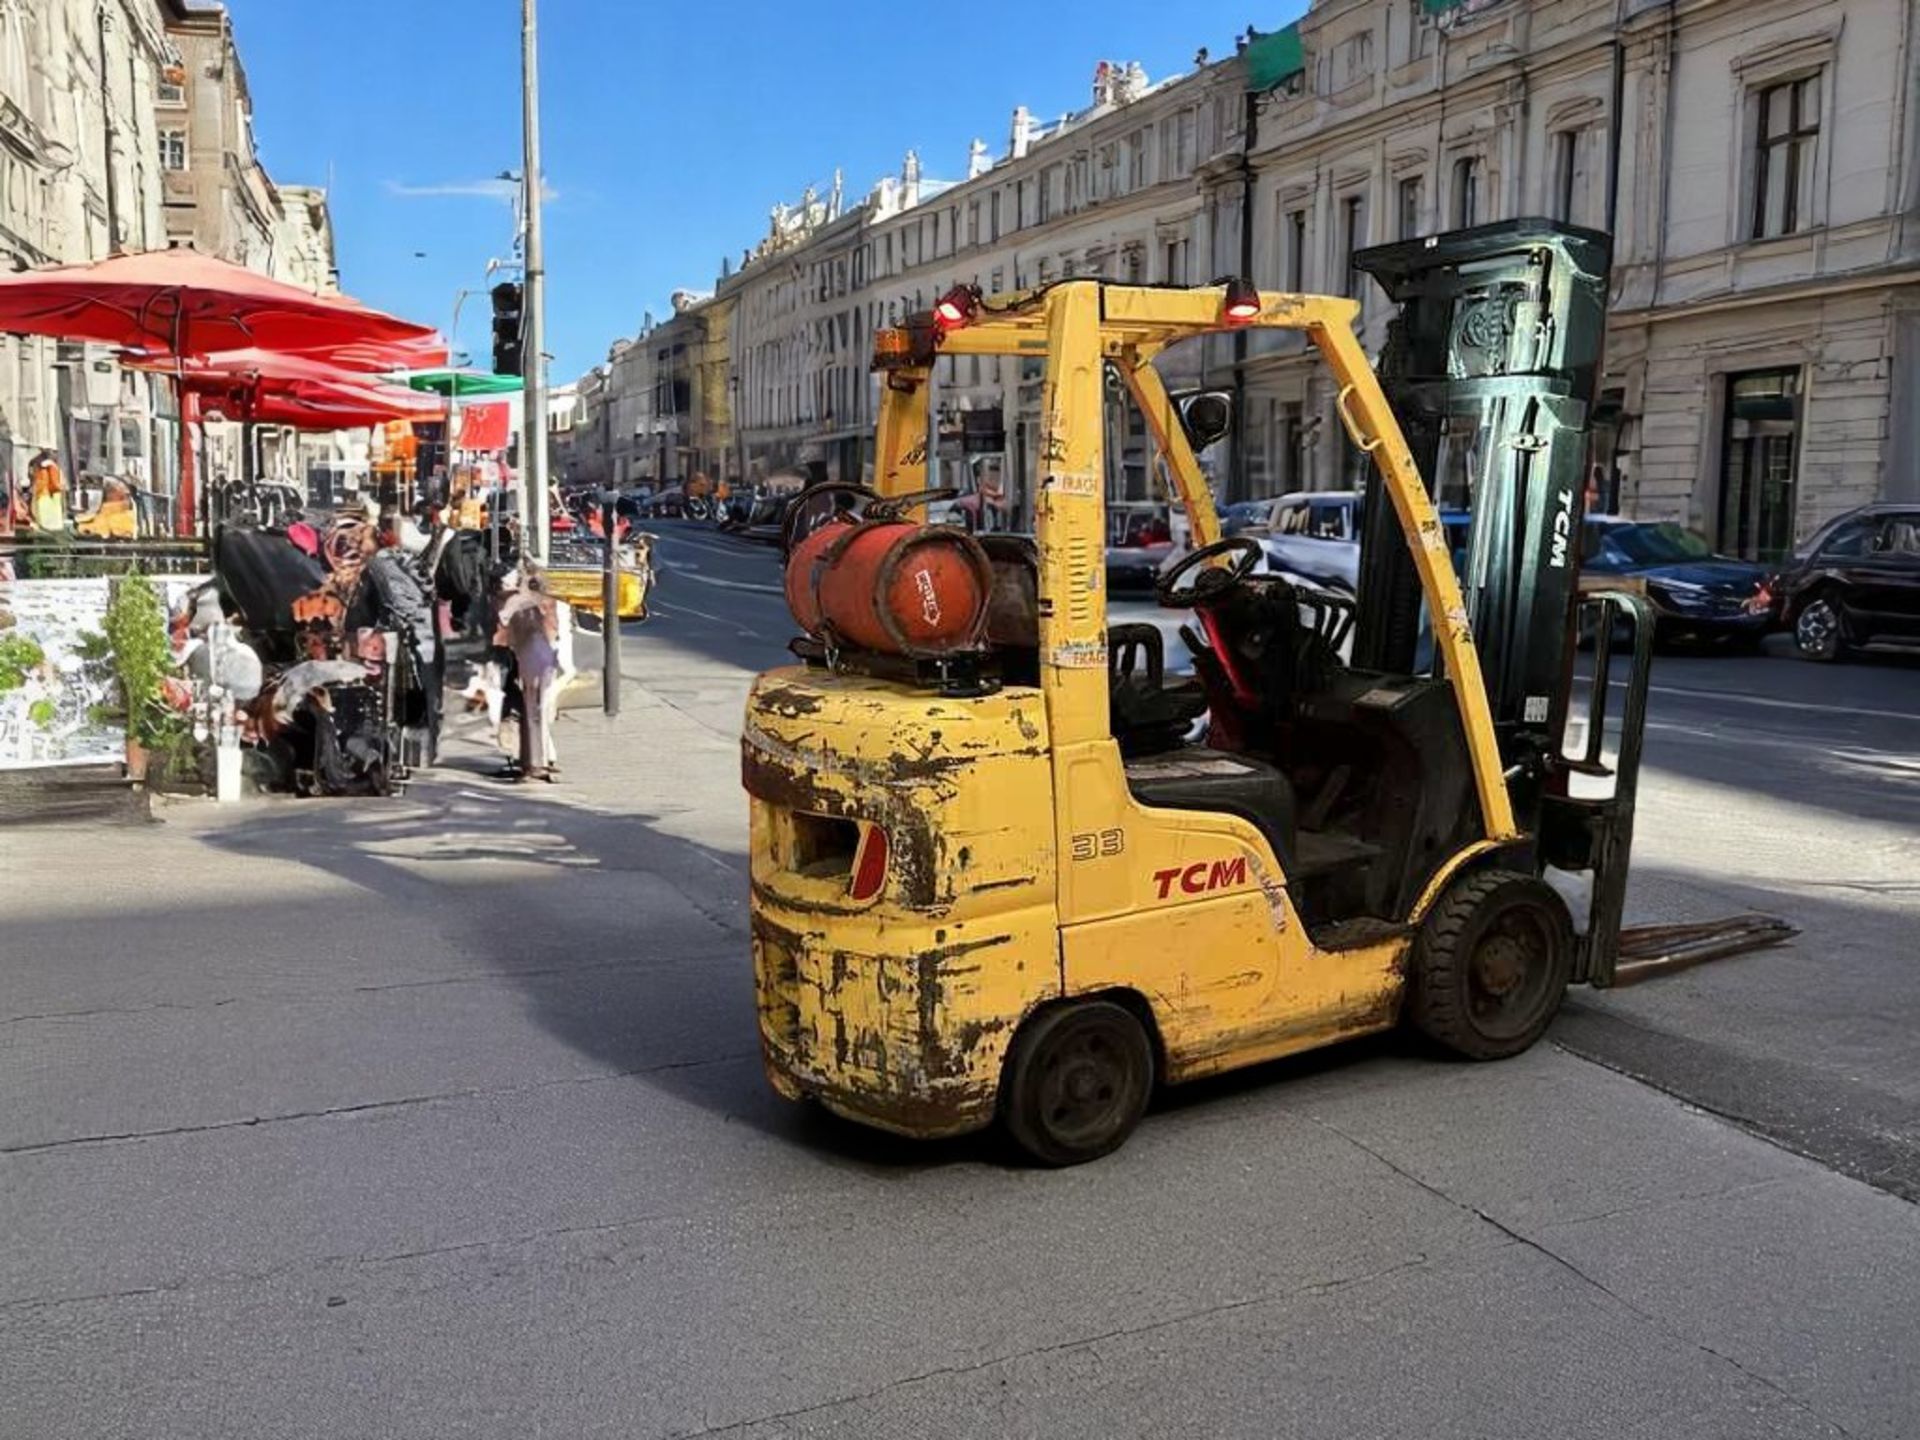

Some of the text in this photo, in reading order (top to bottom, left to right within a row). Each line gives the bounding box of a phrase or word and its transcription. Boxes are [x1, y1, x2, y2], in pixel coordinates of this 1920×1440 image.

[1550, 489, 1573, 567] TCM
[1071, 827, 1124, 861] 33
[1153, 856, 1247, 900] TCM
